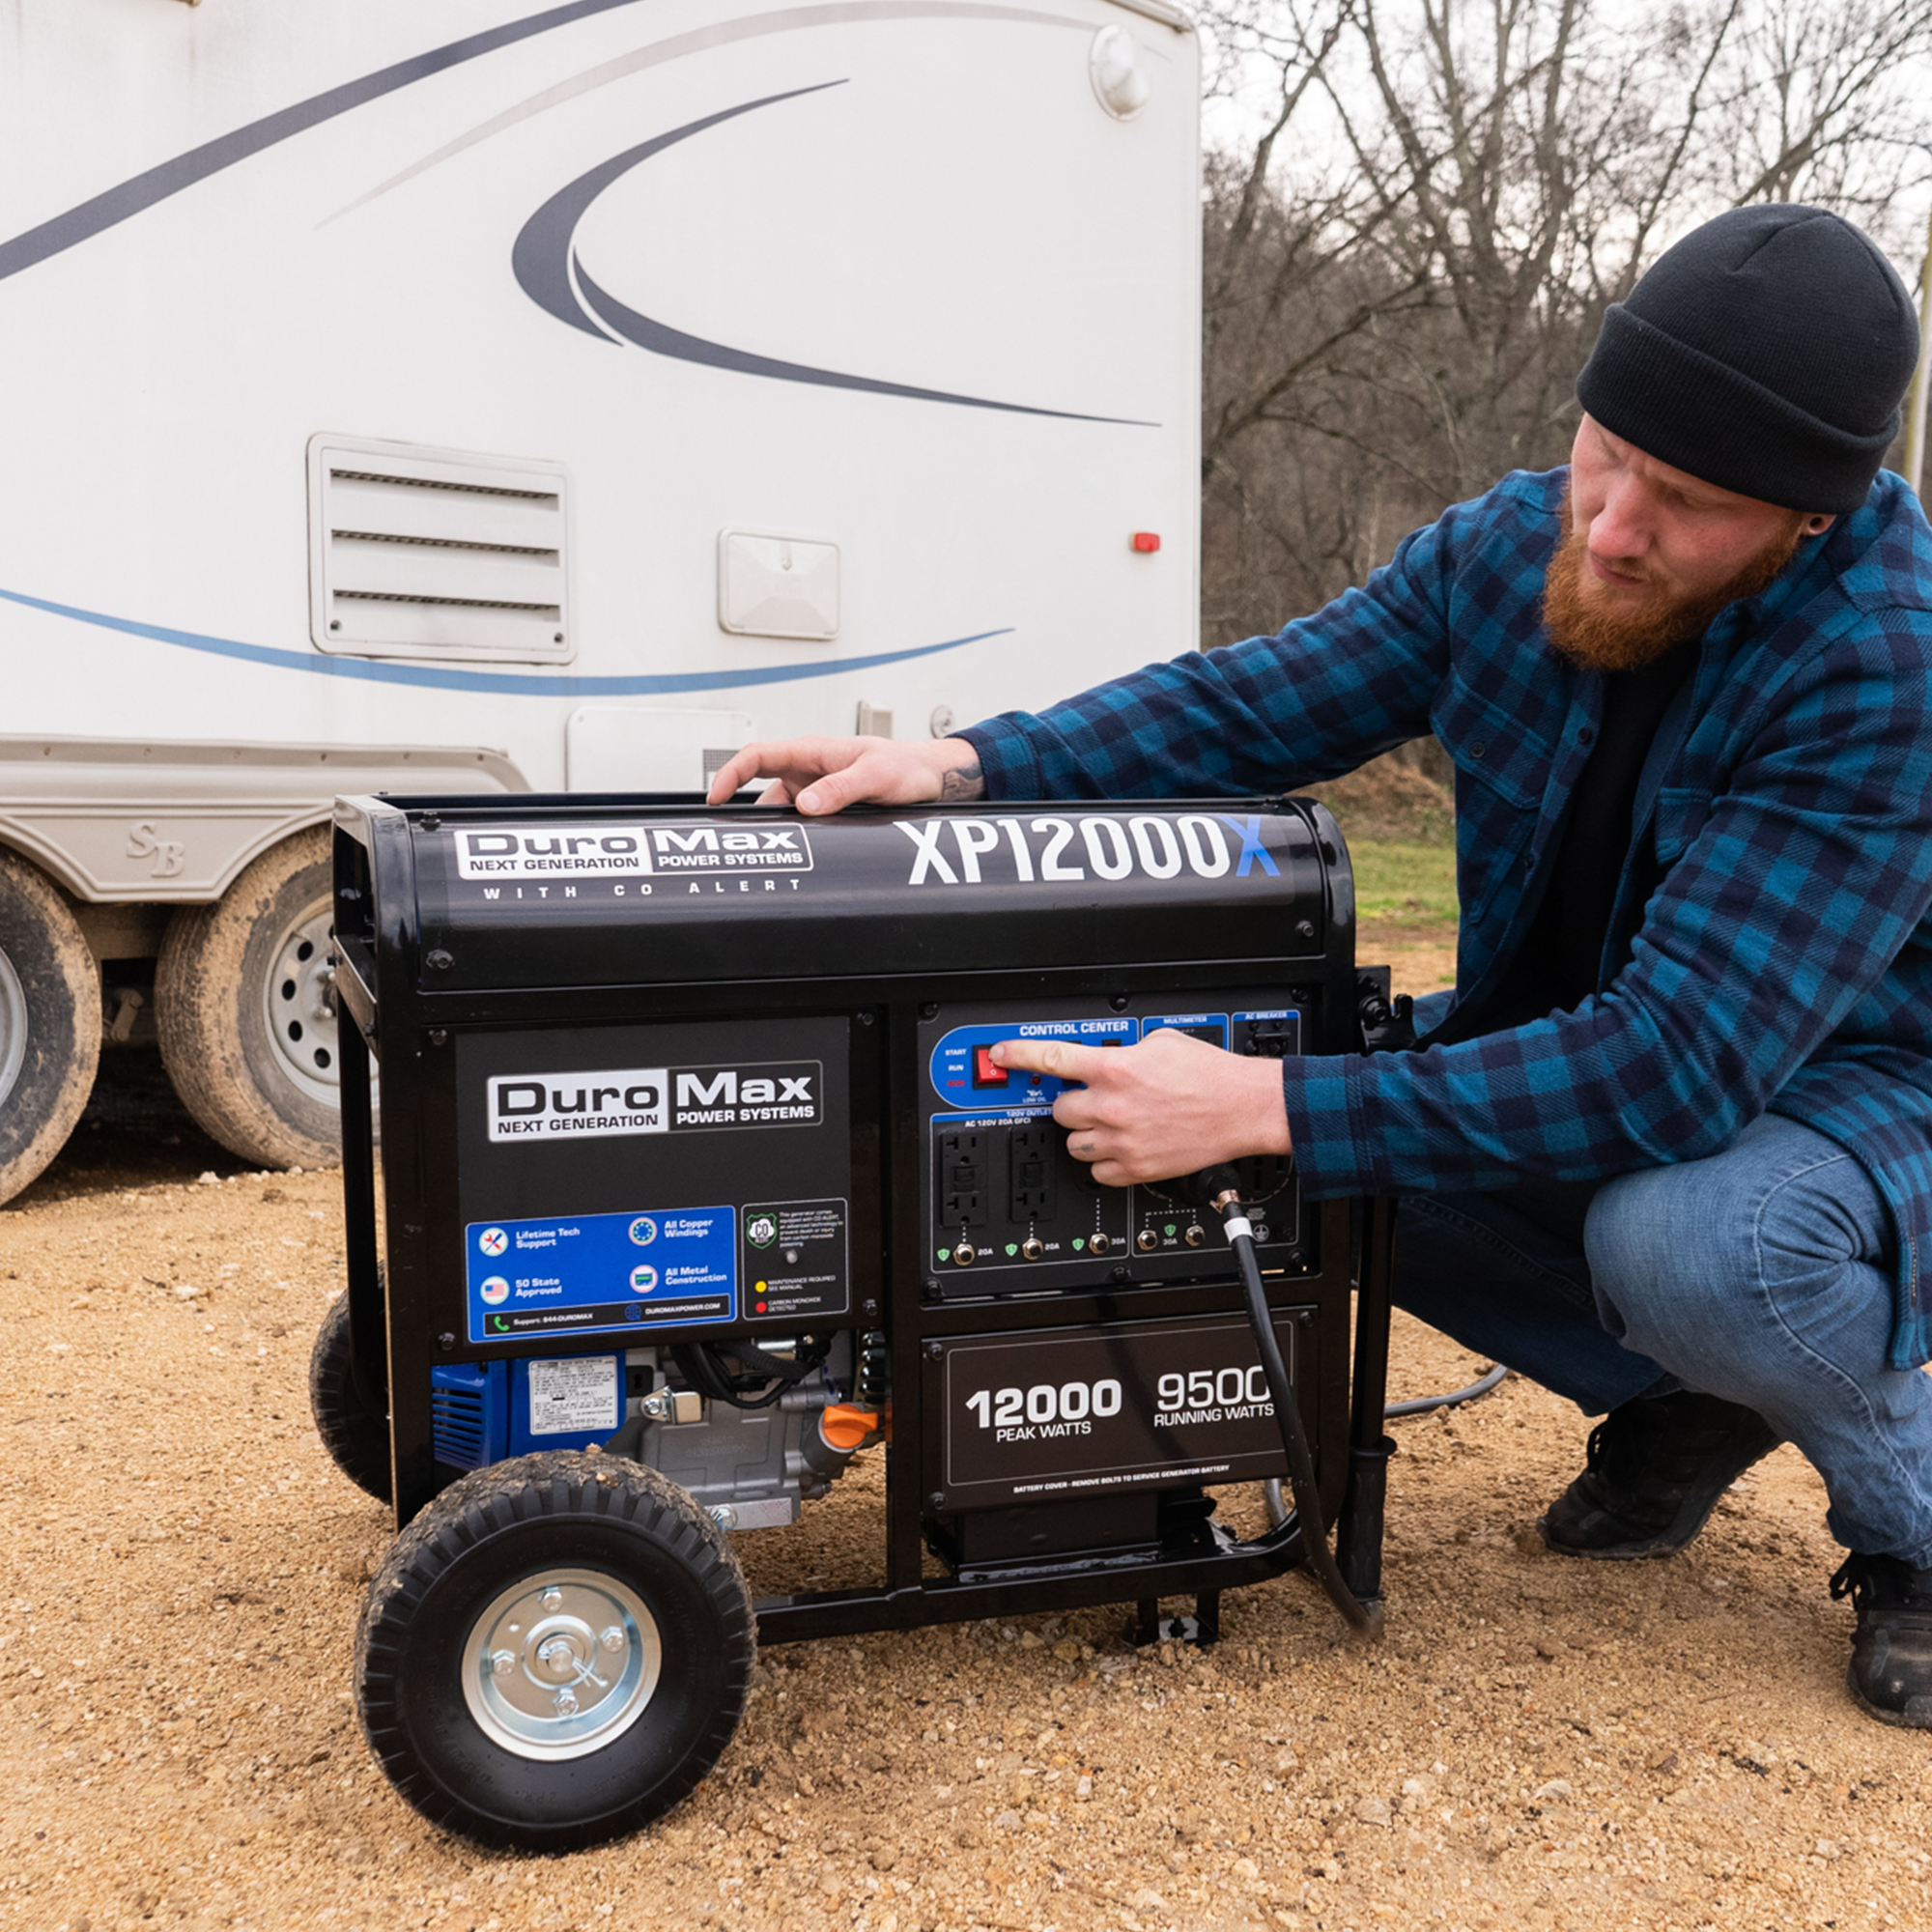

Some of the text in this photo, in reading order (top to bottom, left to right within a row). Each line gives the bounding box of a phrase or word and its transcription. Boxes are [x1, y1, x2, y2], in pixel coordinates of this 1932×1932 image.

[467, 829, 798, 857] Duro Max
[893, 814, 1281, 885] XP12000X
[469, 852, 804, 871] NEXT GENERATION POWER SYSTEMS
[484, 879, 800, 899] WITH CO ALERT
[1019, 1021, 1128, 1037] CONTROL CENTER
[497, 1071, 813, 1117] Duro Max
[498, 1105, 814, 1134] NEXT GENERATION POWER SYSTEMS
[665, 1219, 713, 1229] All Copper
[755, 1223, 768, 1236] CO
[516, 1227, 580, 1239] Lifetime Tech
[665, 1229, 709, 1237] Windings
[516, 1238, 557, 1249] Support
[666, 1265, 708, 1276] All Metal
[516, 1278, 560, 1288] 50 State
[666, 1273, 727, 1286] Construction
[515, 1285, 562, 1298] Approved
[966, 1378, 1122, 1429] 12000
[1154, 1404, 1274, 1427] RUNNING WATTS
[996, 1421, 1092, 1442] PEAK WATTS
[1013, 1484, 1043, 1493] BATTERY
[1044, 1482, 1067, 1491] COVER
[1071, 1478, 1099, 1487] REMOVE
[1101, 1475, 1122, 1485] BOLTS
[1132, 1472, 1159, 1481] SERVICE
[1161, 1467, 1200, 1478] GENERATOR
[1201, 1464, 1231, 1473] BATTERY
